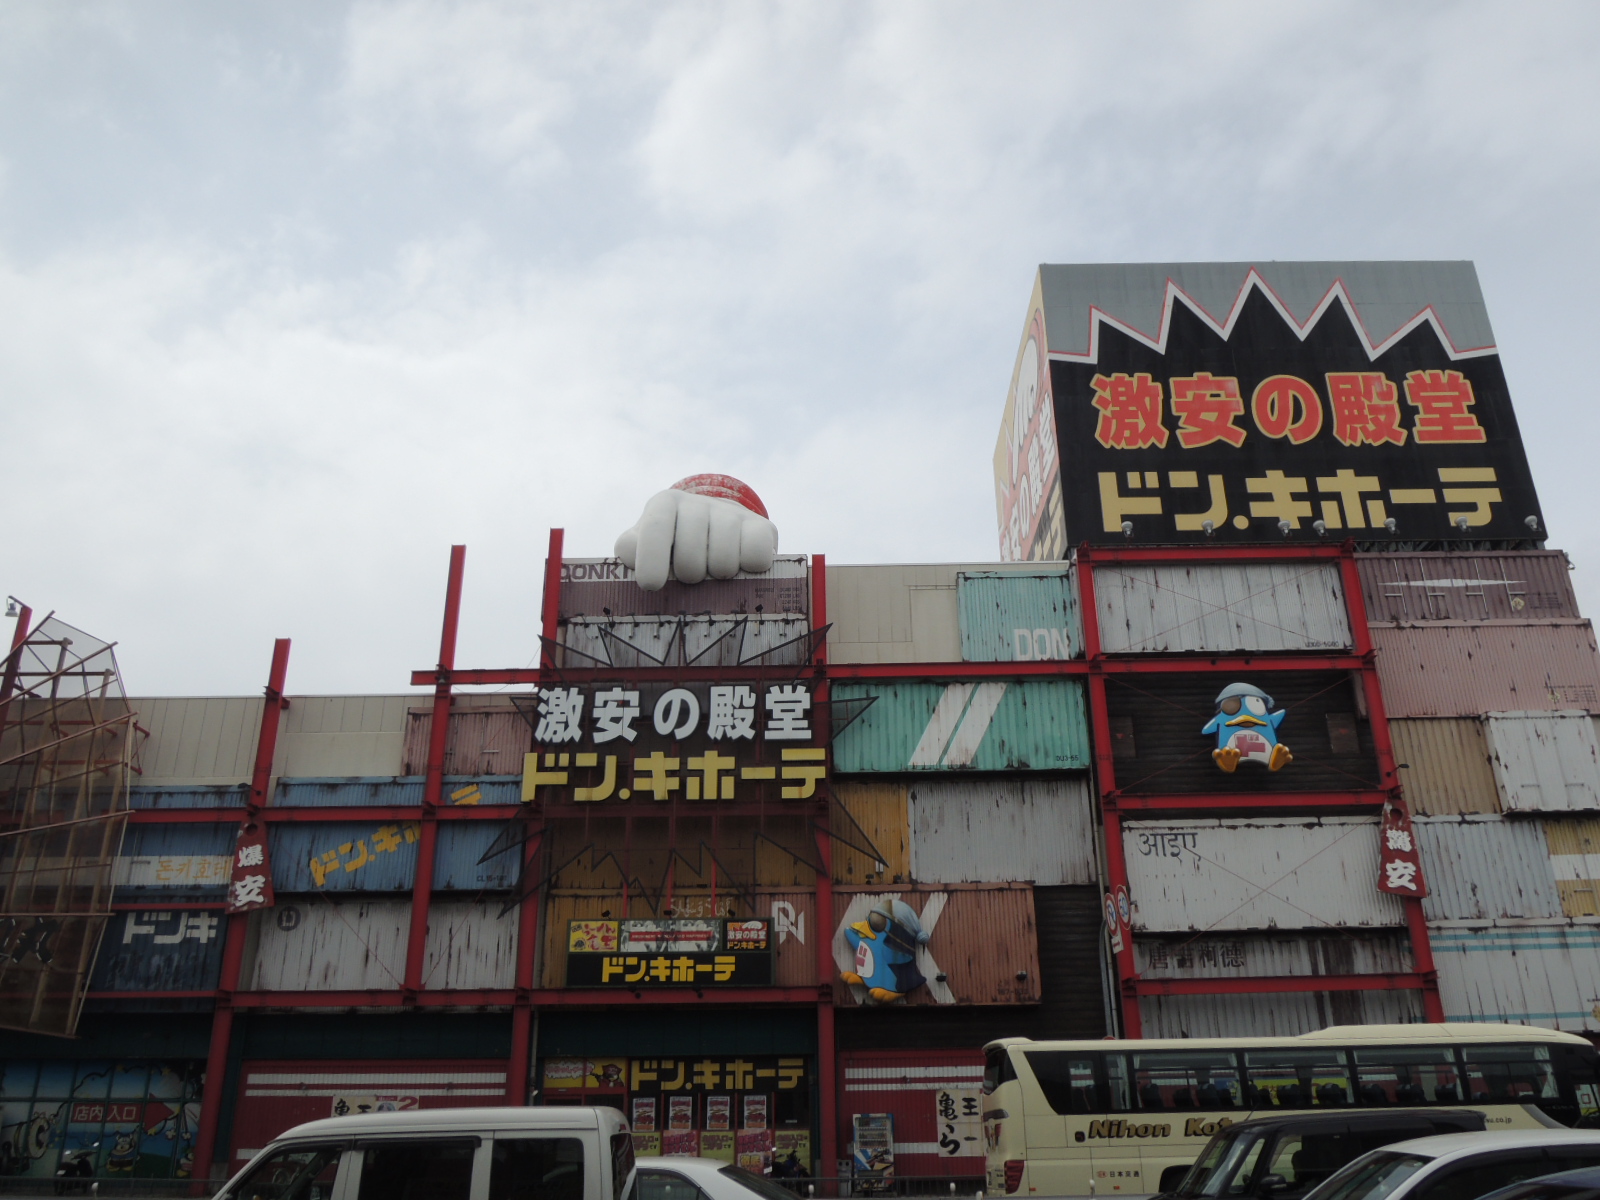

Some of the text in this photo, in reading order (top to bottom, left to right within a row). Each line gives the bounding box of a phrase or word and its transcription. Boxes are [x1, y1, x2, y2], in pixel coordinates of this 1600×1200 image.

[1090, 370, 1487, 449] 激安の殿堂
[1013, 628, 1068, 660] DON
[534, 685, 812, 744] 激安の殿堂
[123, 911, 218, 944] ドンキ
[73, 1105, 137, 1121] 店内入口
[1088, 1119, 1171, 1139] Nihon
